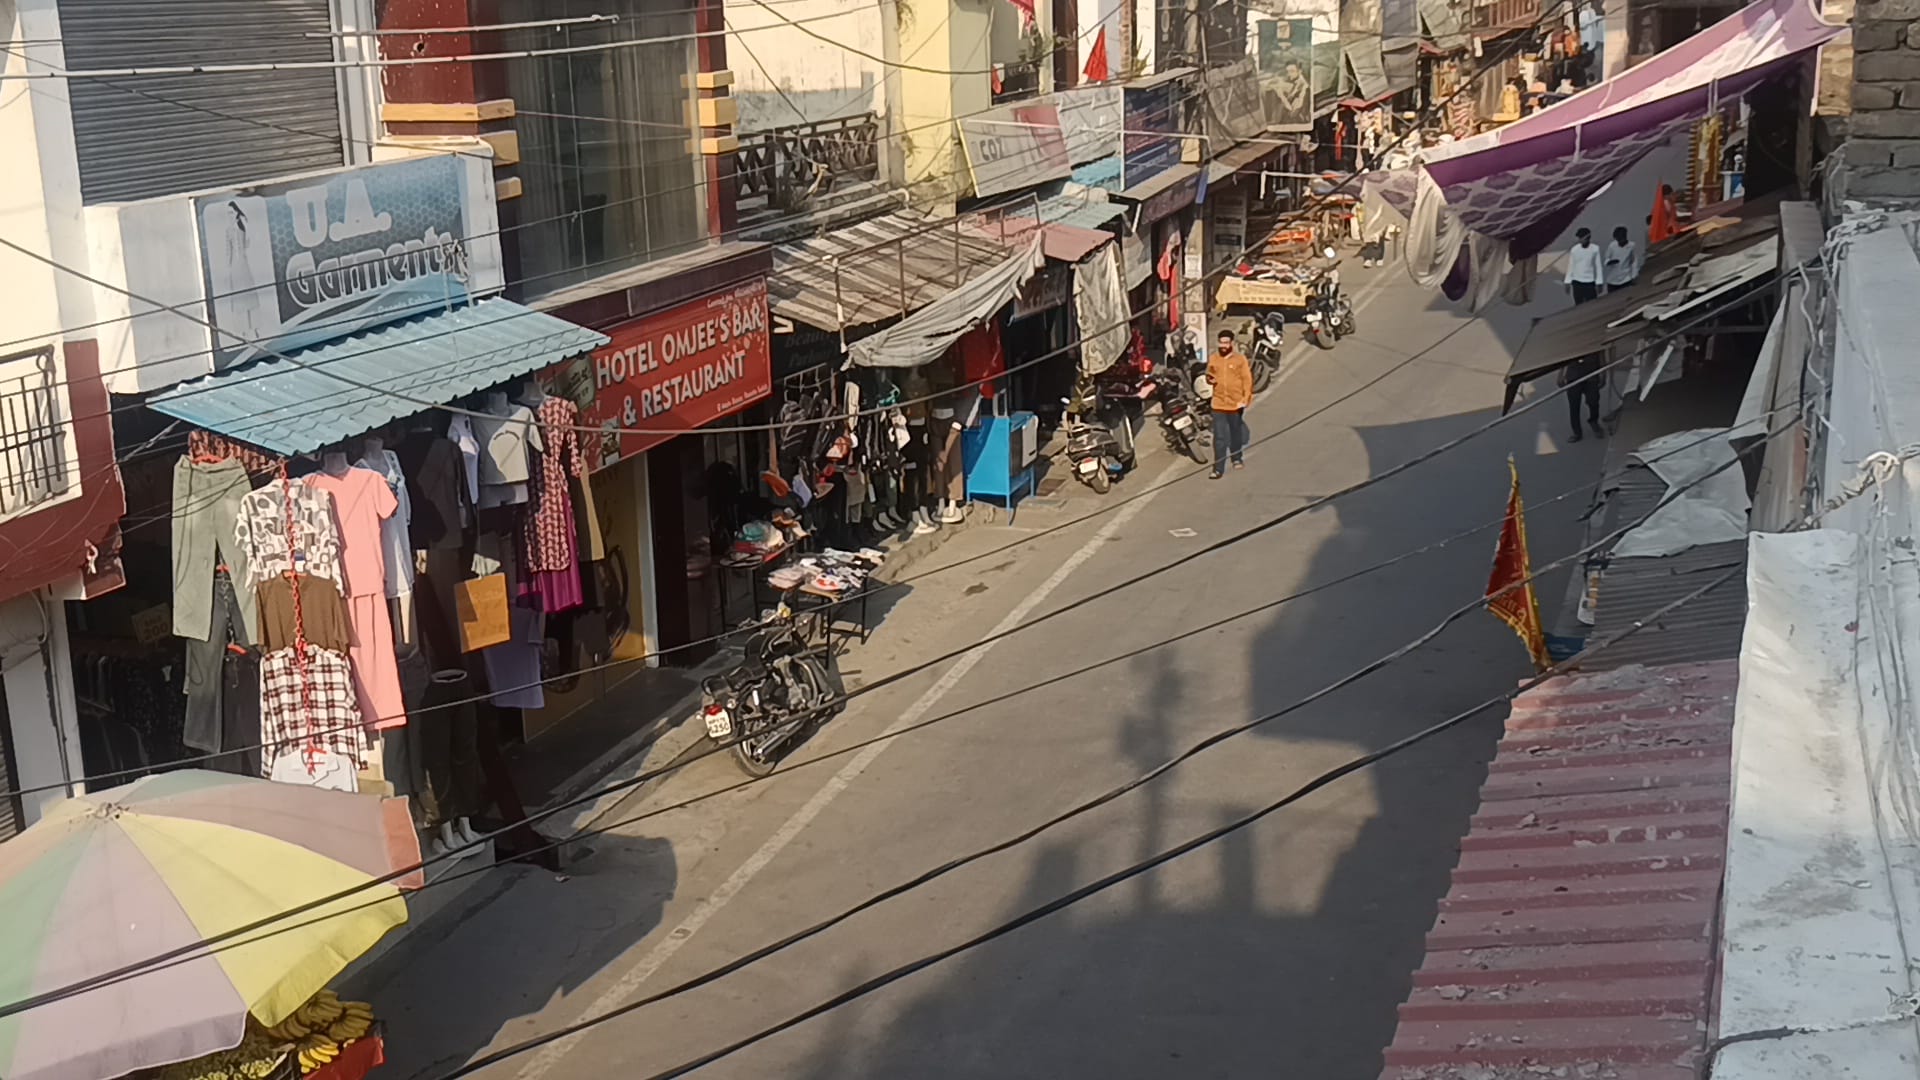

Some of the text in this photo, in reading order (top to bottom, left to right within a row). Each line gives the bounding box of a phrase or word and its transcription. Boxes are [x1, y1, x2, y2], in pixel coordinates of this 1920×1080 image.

[596, 300, 764, 389] HOTEL OMJEE'S BAR
[623, 395, 637, 426] &
[641, 350, 746, 419] RESTAURANT
